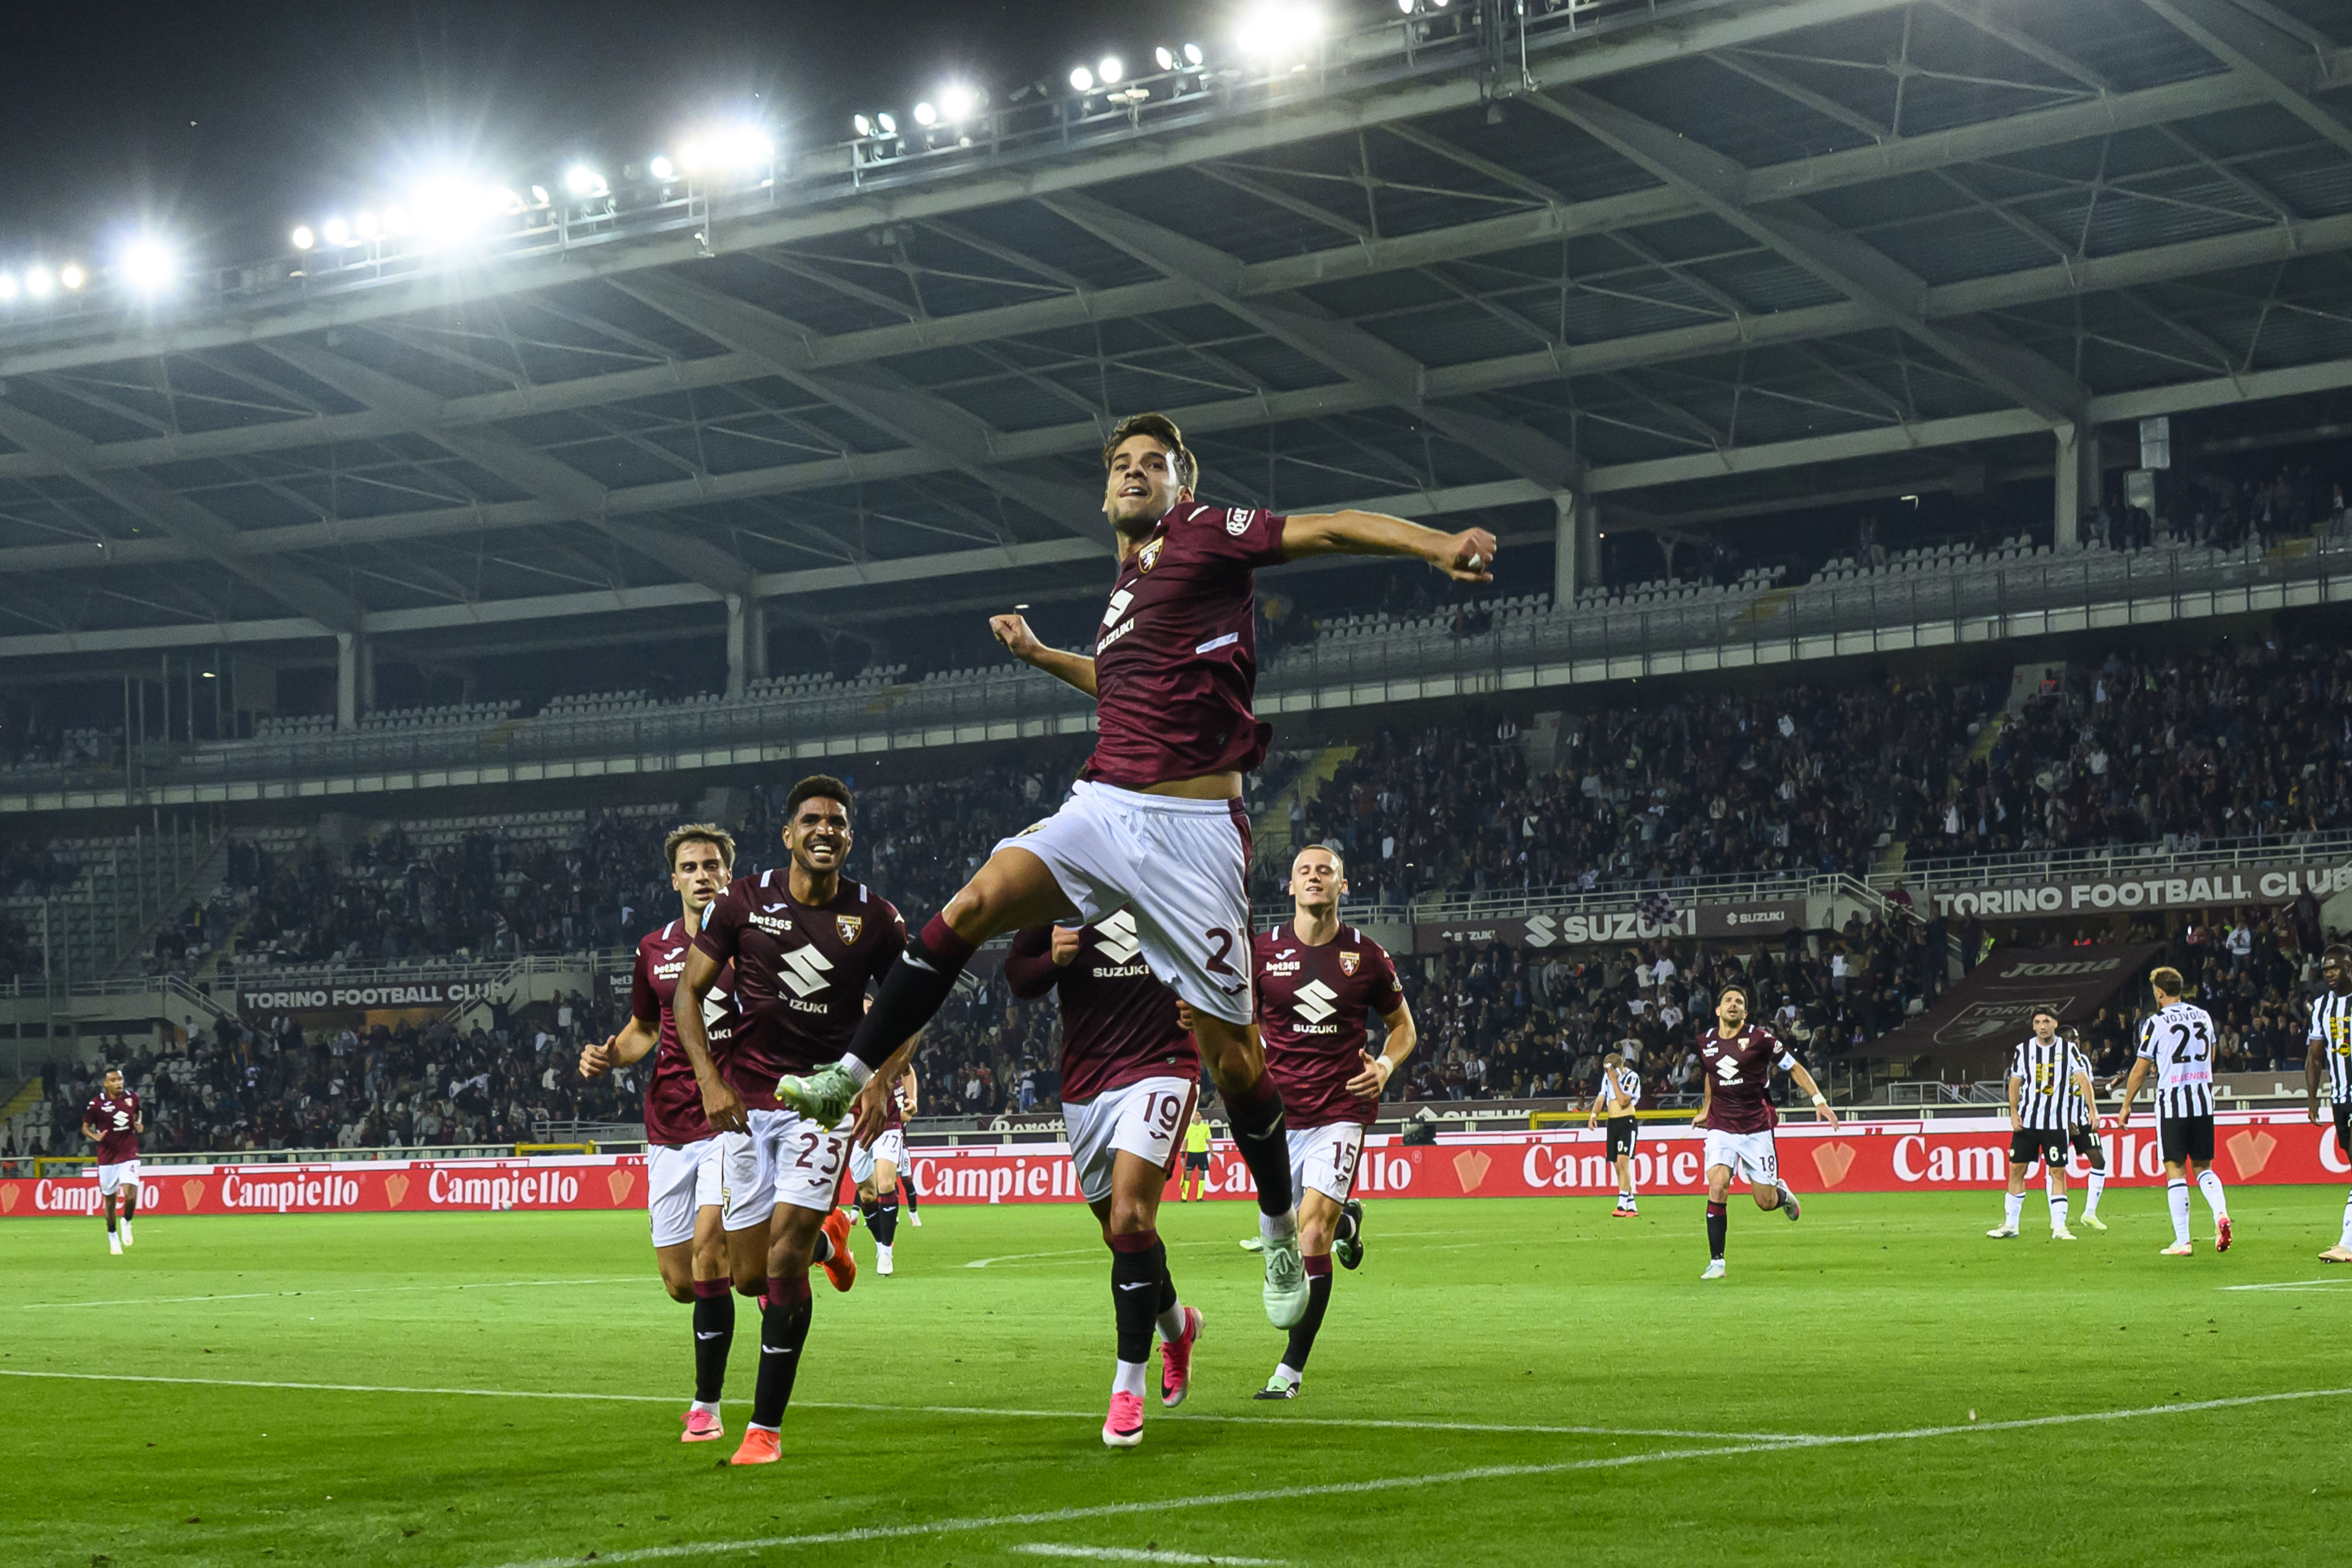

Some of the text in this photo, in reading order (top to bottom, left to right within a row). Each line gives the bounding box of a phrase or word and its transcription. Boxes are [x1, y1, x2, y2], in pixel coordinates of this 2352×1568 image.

[1096, 618, 1134, 656] SUZUKI
[1933, 887, 2063, 917] TORINO
[2071, 875, 2252, 909] FOOTBALL
[749, 912, 792, 930] bet365
[1739, 911, 1785, 923] SUZUKI
[1454, 930, 1496, 941] SZUK
[1092, 964, 1149, 978] SUZUKI
[1266, 956, 1300, 971] bet365
[610, 975, 633, 986] bet3
[244, 991, 327, 1009] TORINO
[332, 986, 443, 1006] FOOTBALL
[778, 991, 827, 1013] SZUKI
[708, 1029, 732, 1040] UKI
[1292, 1024, 1337, 1034] SUZUKI
[2169, 1021, 2209, 1064] 23
[1143, 1092, 1181, 1131] 19
[2088, 1133, 2100, 1146] 11
[796, 1133, 842, 1174] 23
[1332, 1141, 1356, 1174] 15
[1759, 1155, 1774, 1172] 18
[2049, 1146, 2059, 1162] 6
[428, 1169, 579, 1210] Campiello
[912, 1158, 1081, 1204] Campiell
[221, 1173, 359, 1212] Campiello
